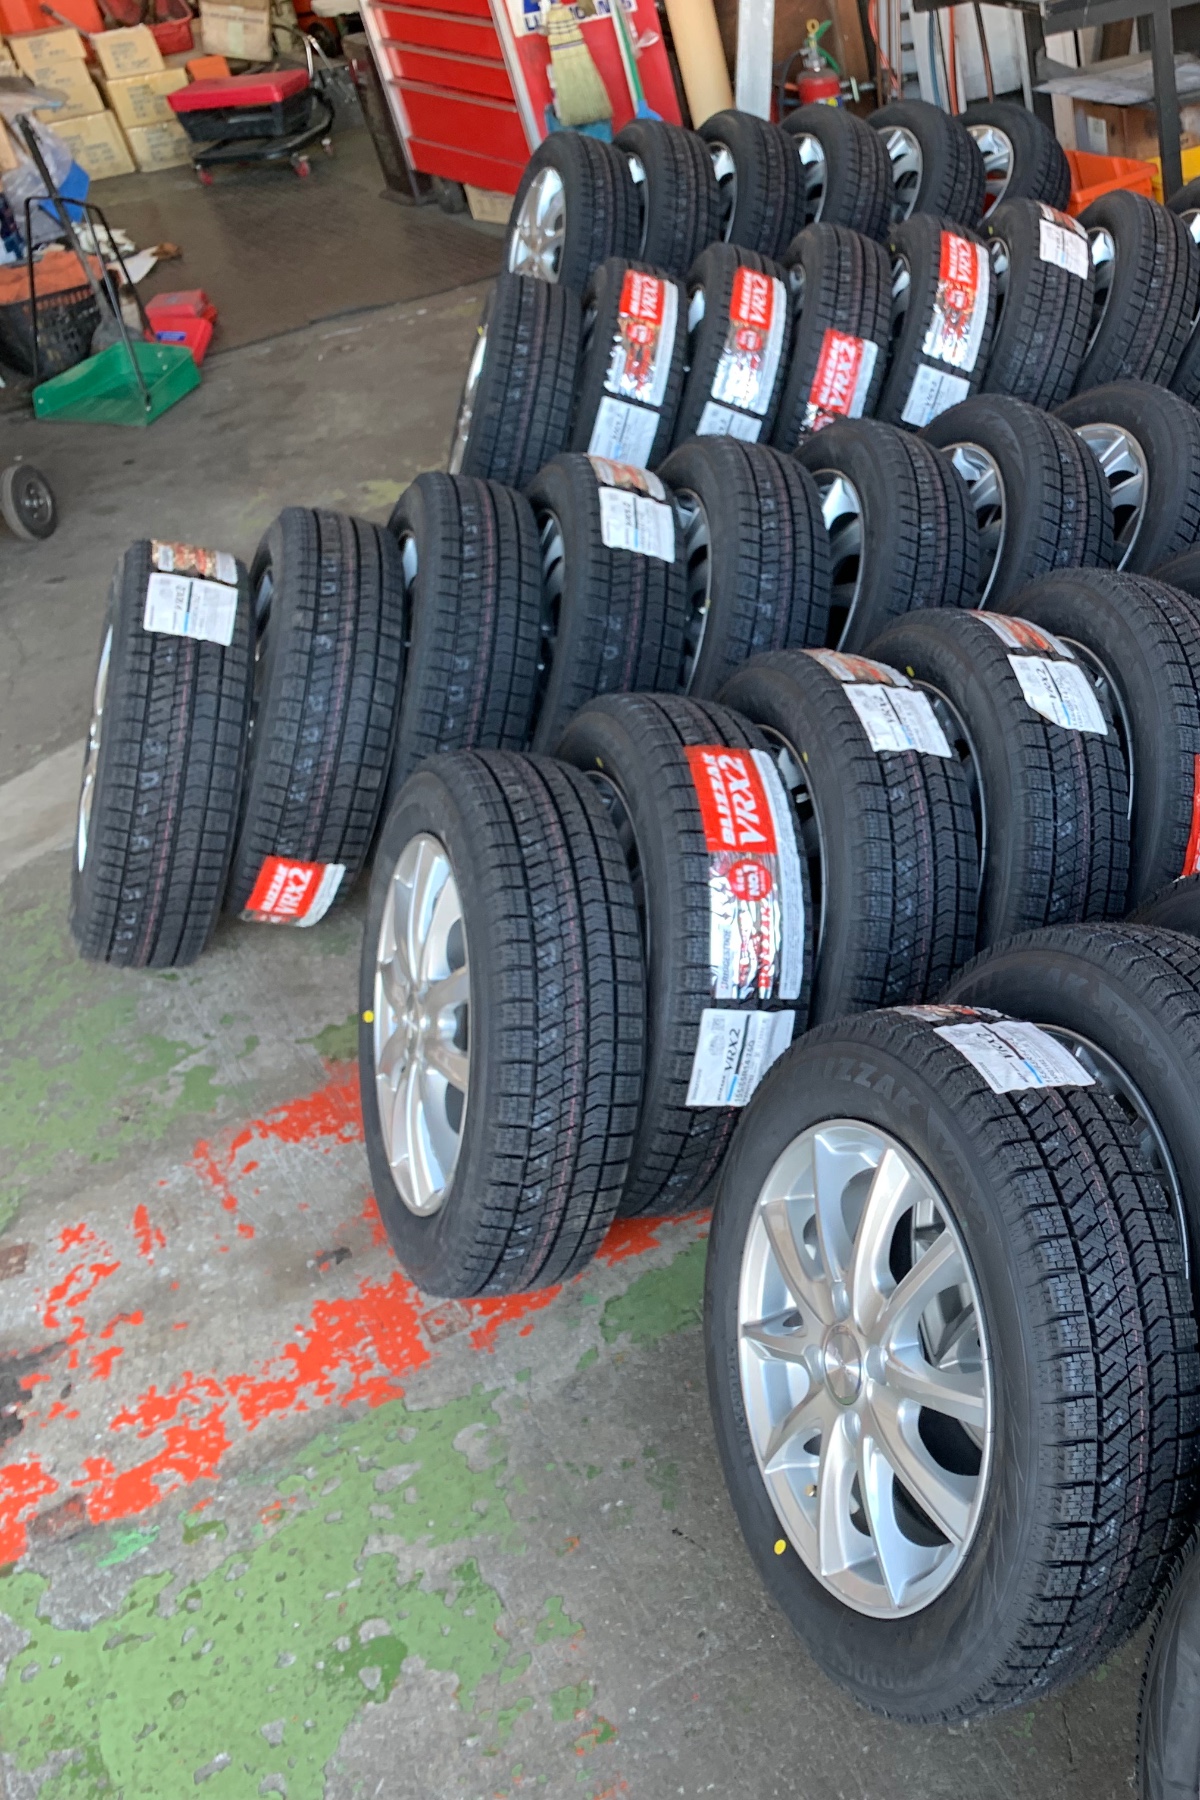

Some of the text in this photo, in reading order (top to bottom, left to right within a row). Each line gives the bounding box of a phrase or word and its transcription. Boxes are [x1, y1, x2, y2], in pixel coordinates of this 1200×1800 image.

[750, 274, 768, 324] VRX2
[828, 341, 857, 406] VRX2
[702, 752, 737, 847] BLIZZAK
[718, 754, 768, 846] VRX2
[274, 866, 314, 915] VRX2
[725, 1028, 741, 1071] VRX2
[976, 1031, 1014, 1058] VRX2
